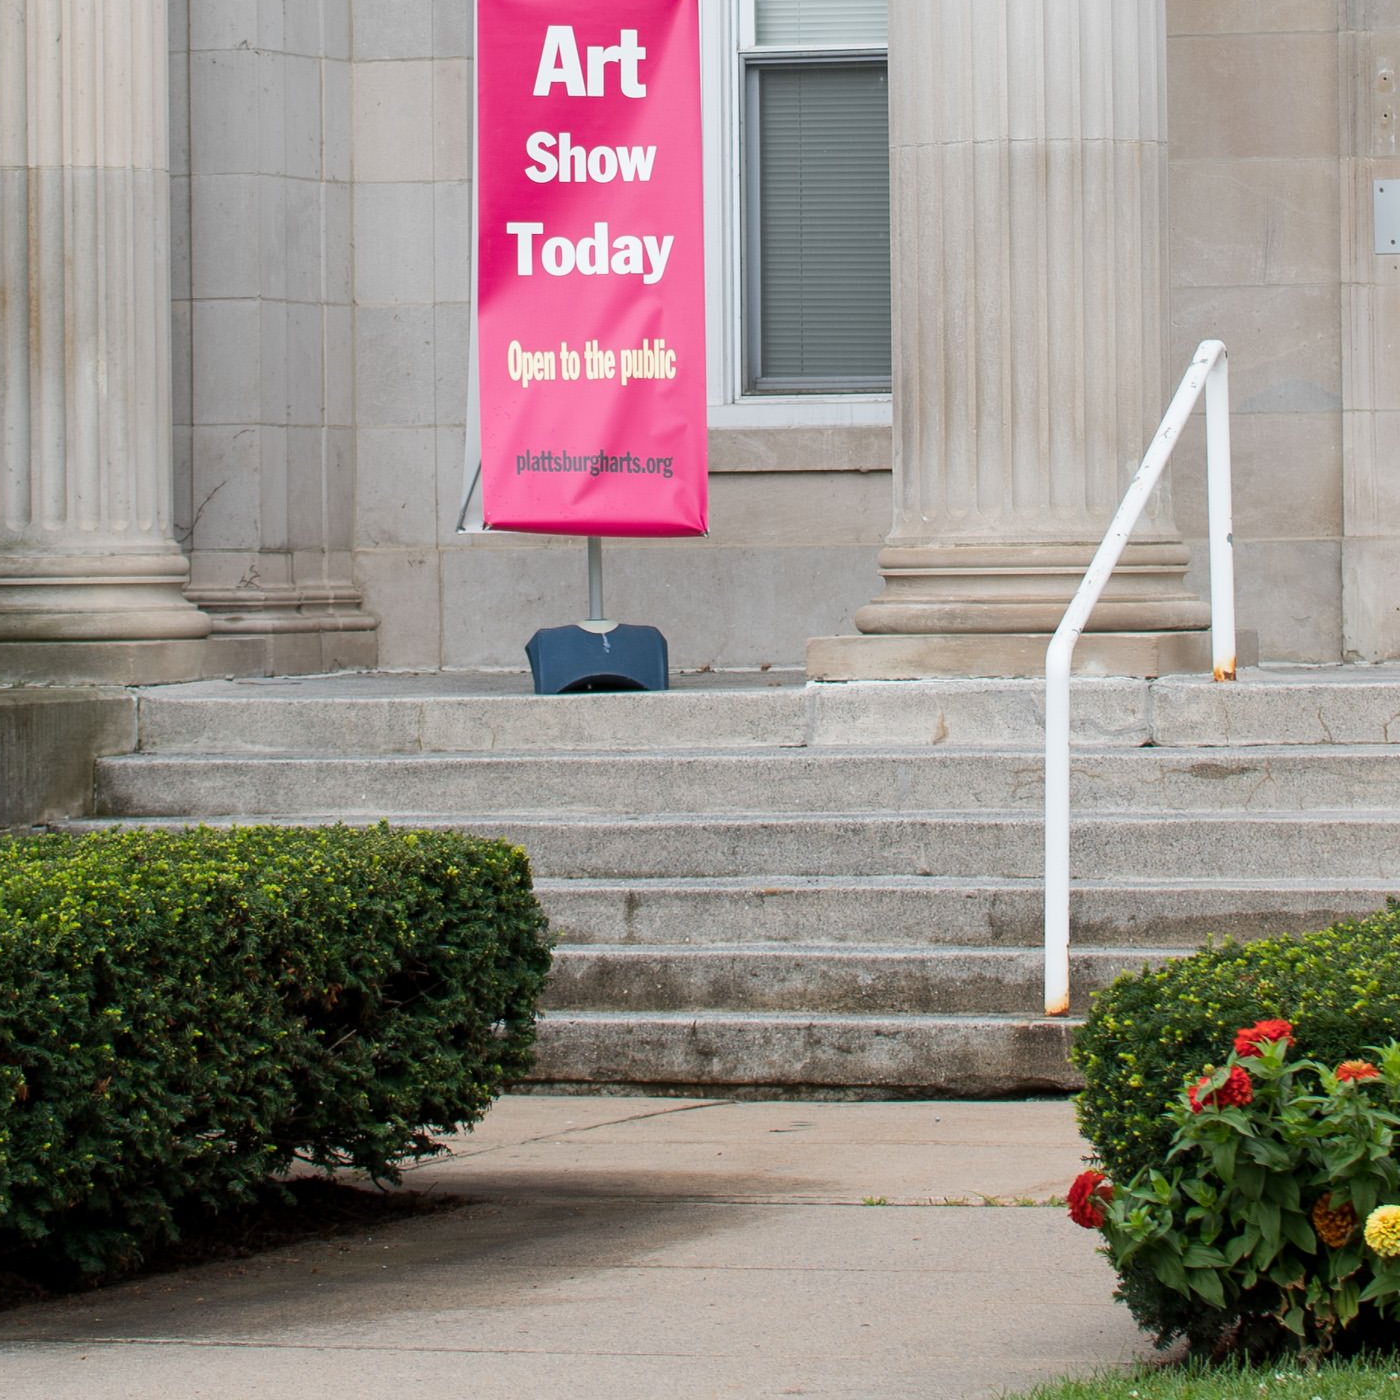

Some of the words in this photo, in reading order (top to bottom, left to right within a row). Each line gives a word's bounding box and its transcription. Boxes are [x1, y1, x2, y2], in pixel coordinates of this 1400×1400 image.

[533, 25, 647, 98] Art
[524, 131, 657, 183] Show
[506, 222, 675, 285] Today
[507, 339, 556, 388] Open
[560, 341, 581, 380] to
[584, 339, 616, 380] the
[620, 338, 677, 386] public
[516, 449, 674, 478] plattsburgharts.org
